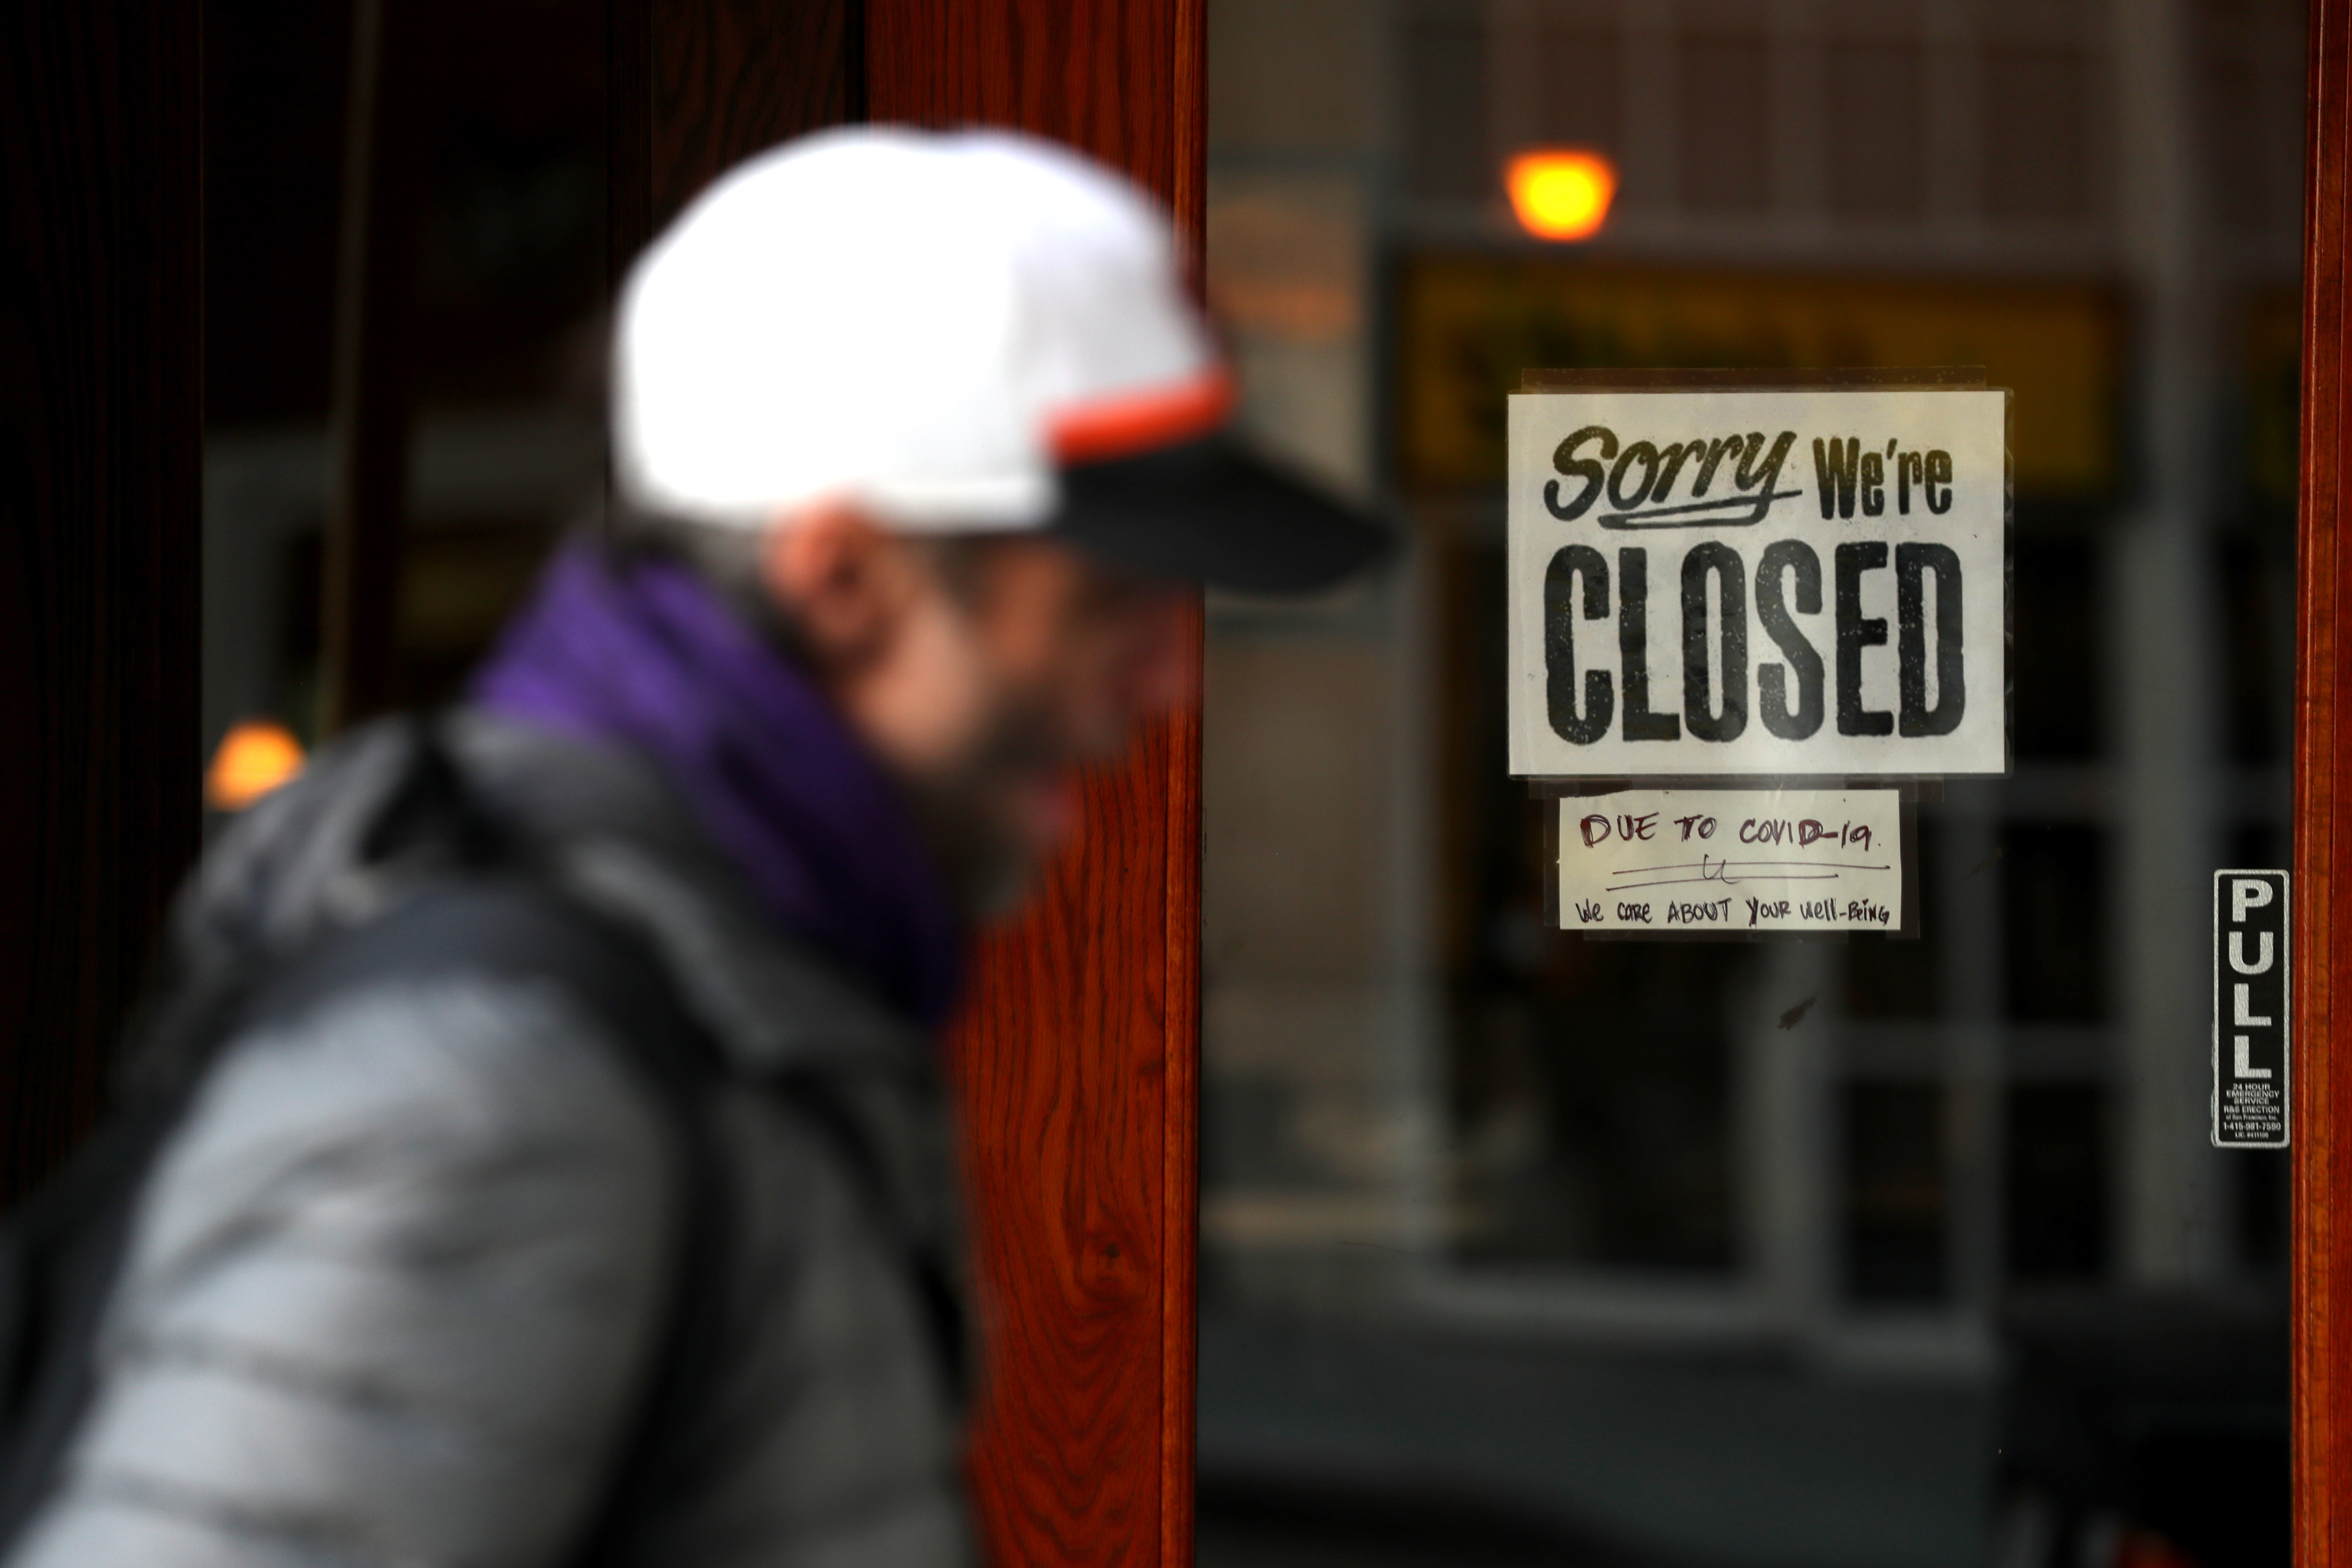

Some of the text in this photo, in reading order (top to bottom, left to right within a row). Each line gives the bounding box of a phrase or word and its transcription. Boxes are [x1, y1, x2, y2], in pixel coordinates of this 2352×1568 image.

[1544, 426, 1953, 530] Sorry We're
[1544, 539, 1966, 745] CLOSED
[1580, 812, 1660, 848] DUE
[1675, 814, 1717, 841] TO
[1667, 898, 1732, 923] ABOUT
[1746, 896, 1792, 926] YOUR
[2229, 879, 2274, 1078] PULL
[2223, 1105, 2280, 1114] R&S ERECTION
[2226, 1090, 2280, 1098] EMERGENCY
[2234, 1096, 2269, 1105] SERVICE
